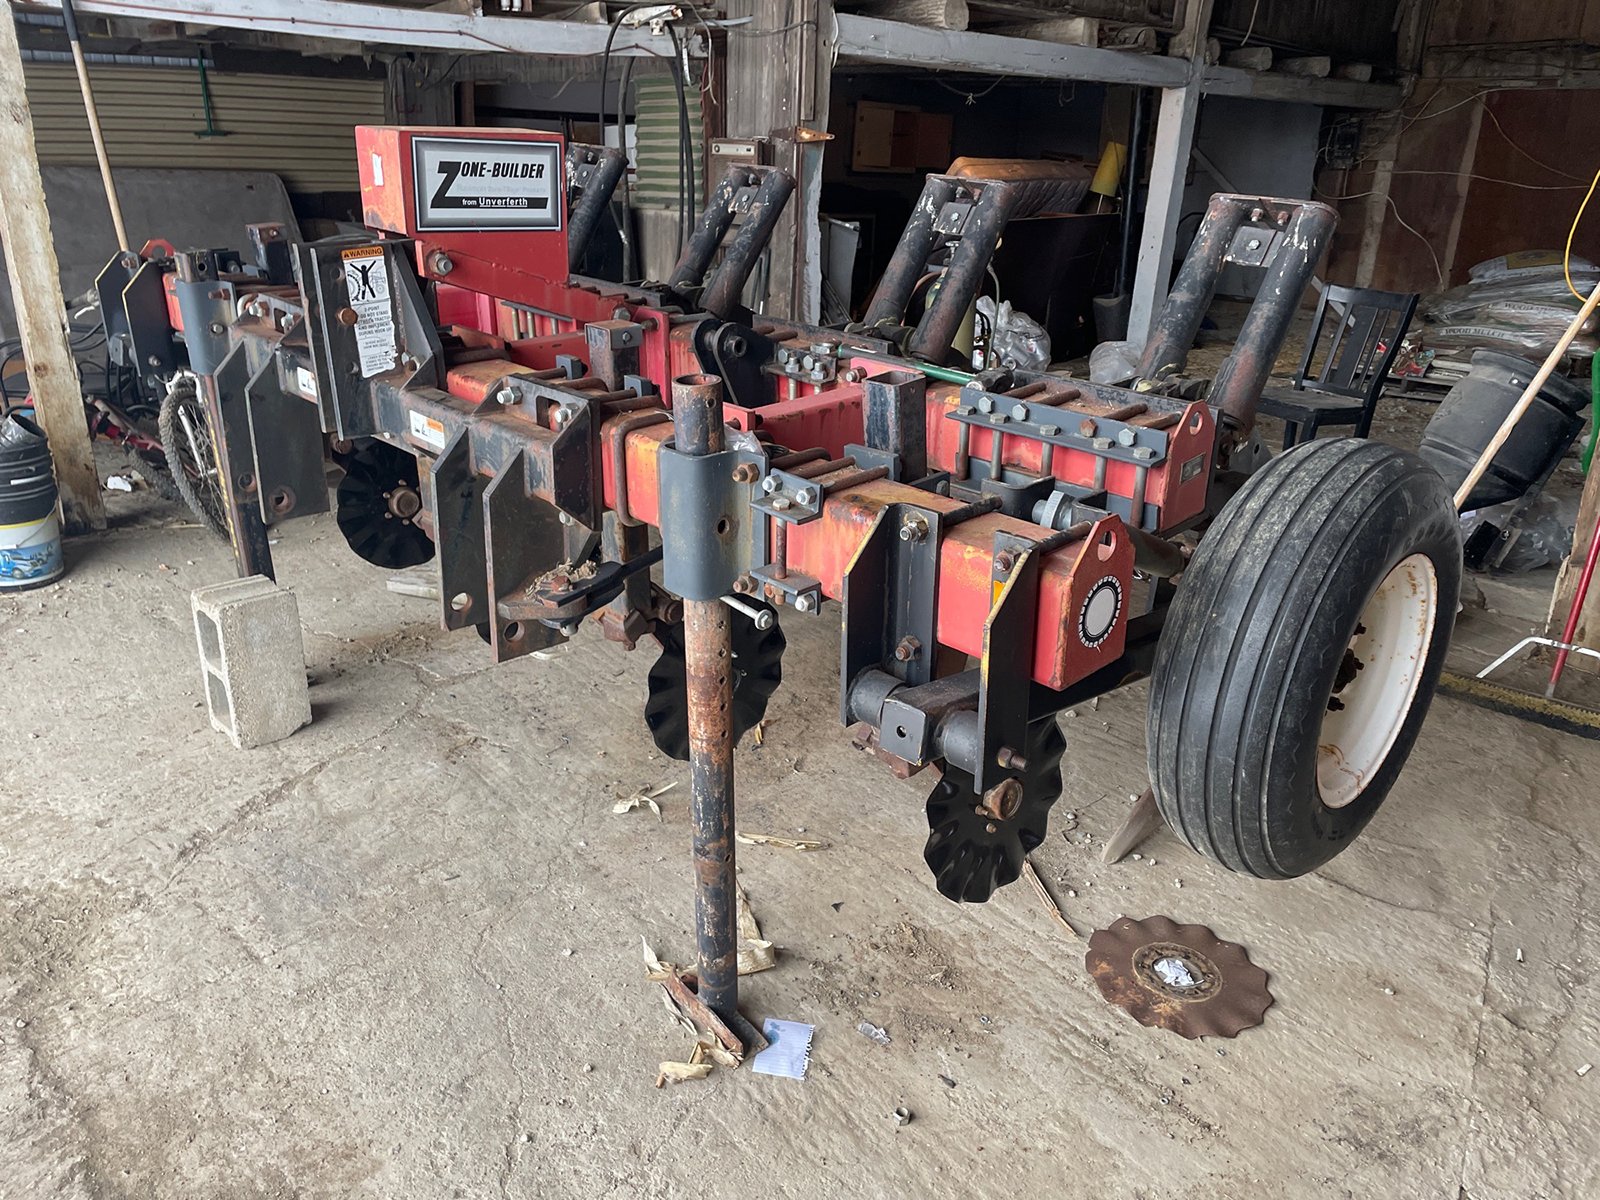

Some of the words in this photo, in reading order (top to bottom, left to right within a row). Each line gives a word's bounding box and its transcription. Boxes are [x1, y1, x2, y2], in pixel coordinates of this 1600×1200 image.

[430, 161, 548, 209] ZONE-BUILDER
[479, 197, 528, 207] Unverferth
[350, 248, 383, 257] WARNING
